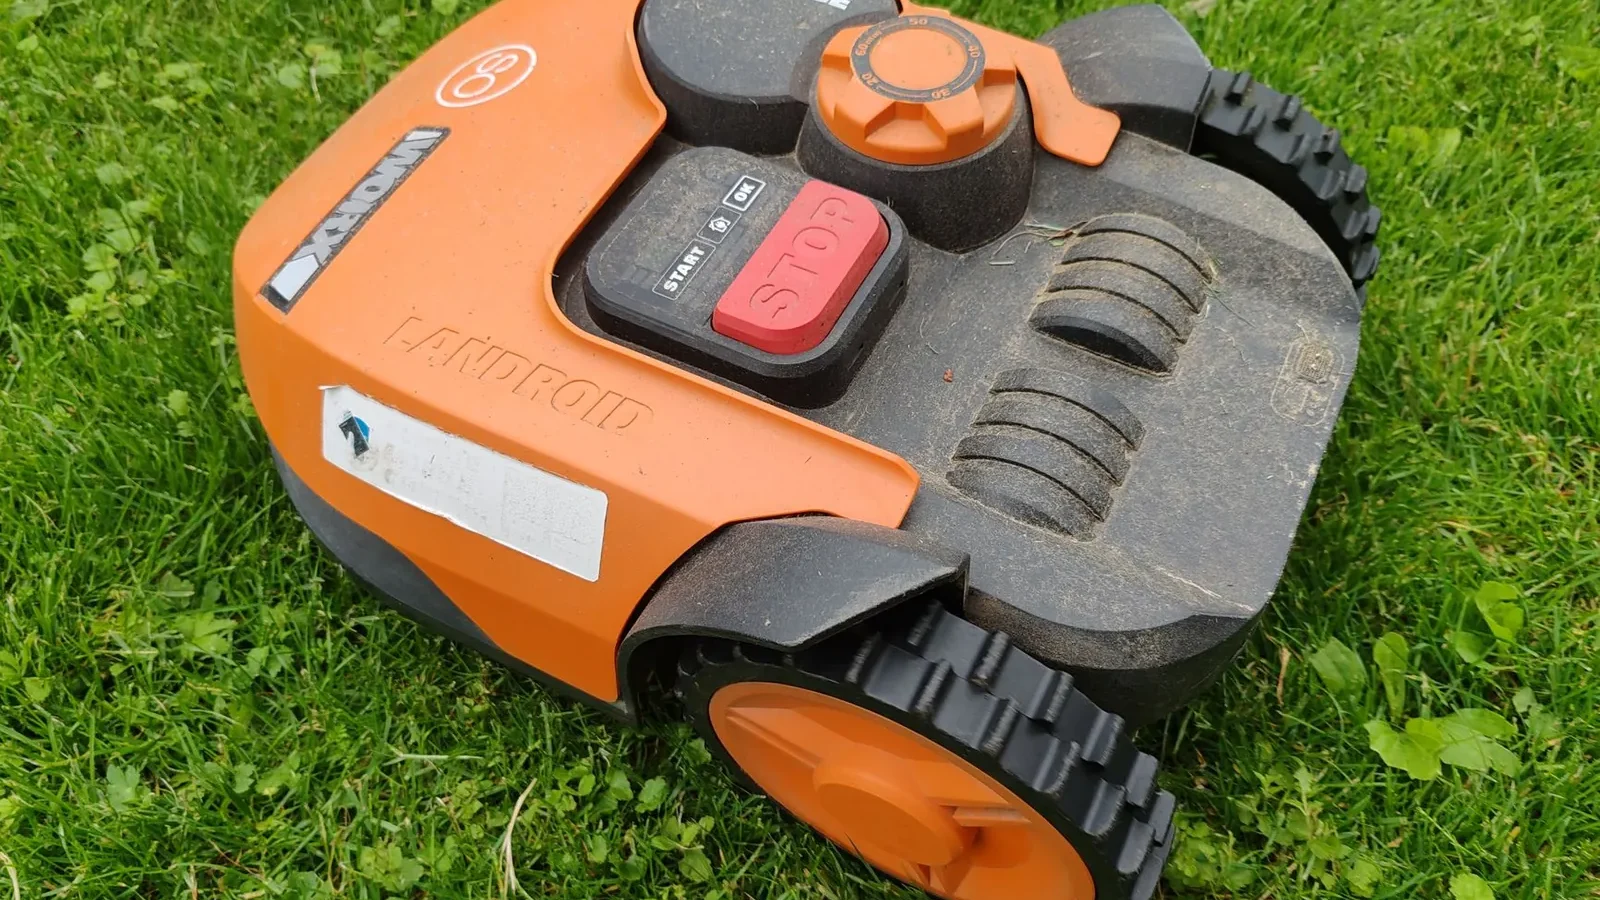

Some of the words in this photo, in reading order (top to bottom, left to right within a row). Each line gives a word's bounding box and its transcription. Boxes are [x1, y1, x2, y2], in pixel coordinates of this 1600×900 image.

[908, 17, 928, 26] 50
[968, 44, 981, 58] 40
[861, 72, 880, 86] 20
[931, 87, 951, 99] 30
[290, 131, 440, 267] WORX
[733, 182, 756, 203] OK
[748, 196, 856, 319] STOP
[663, 245, 706, 293] START
[382, 315, 655, 437] LANDROID
